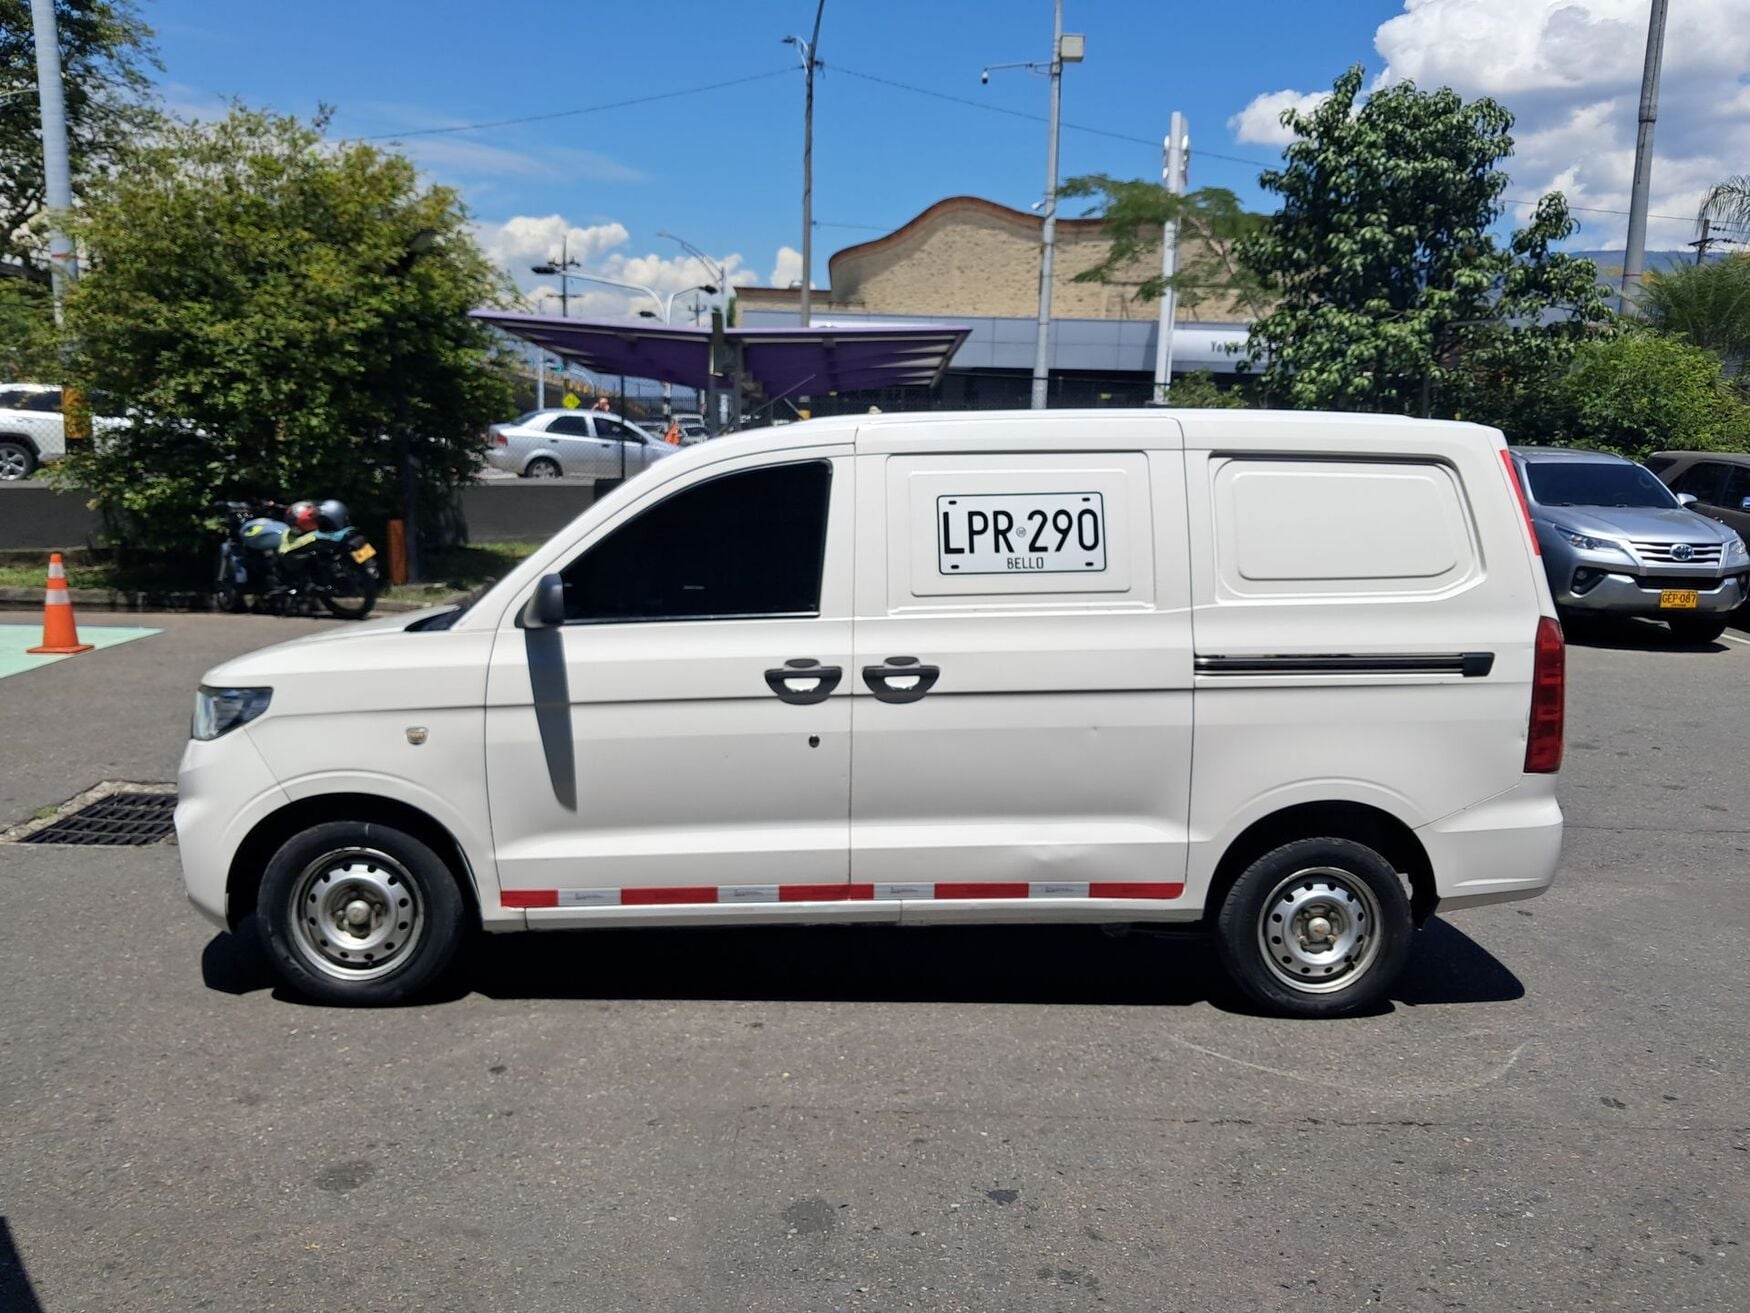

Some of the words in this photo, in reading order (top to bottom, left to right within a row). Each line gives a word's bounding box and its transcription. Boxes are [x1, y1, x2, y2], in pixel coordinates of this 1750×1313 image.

[943, 510, 1015, 554] LPR
[1027, 508, 1099, 552] 290
[1007, 557, 1044, 569] BELLO
